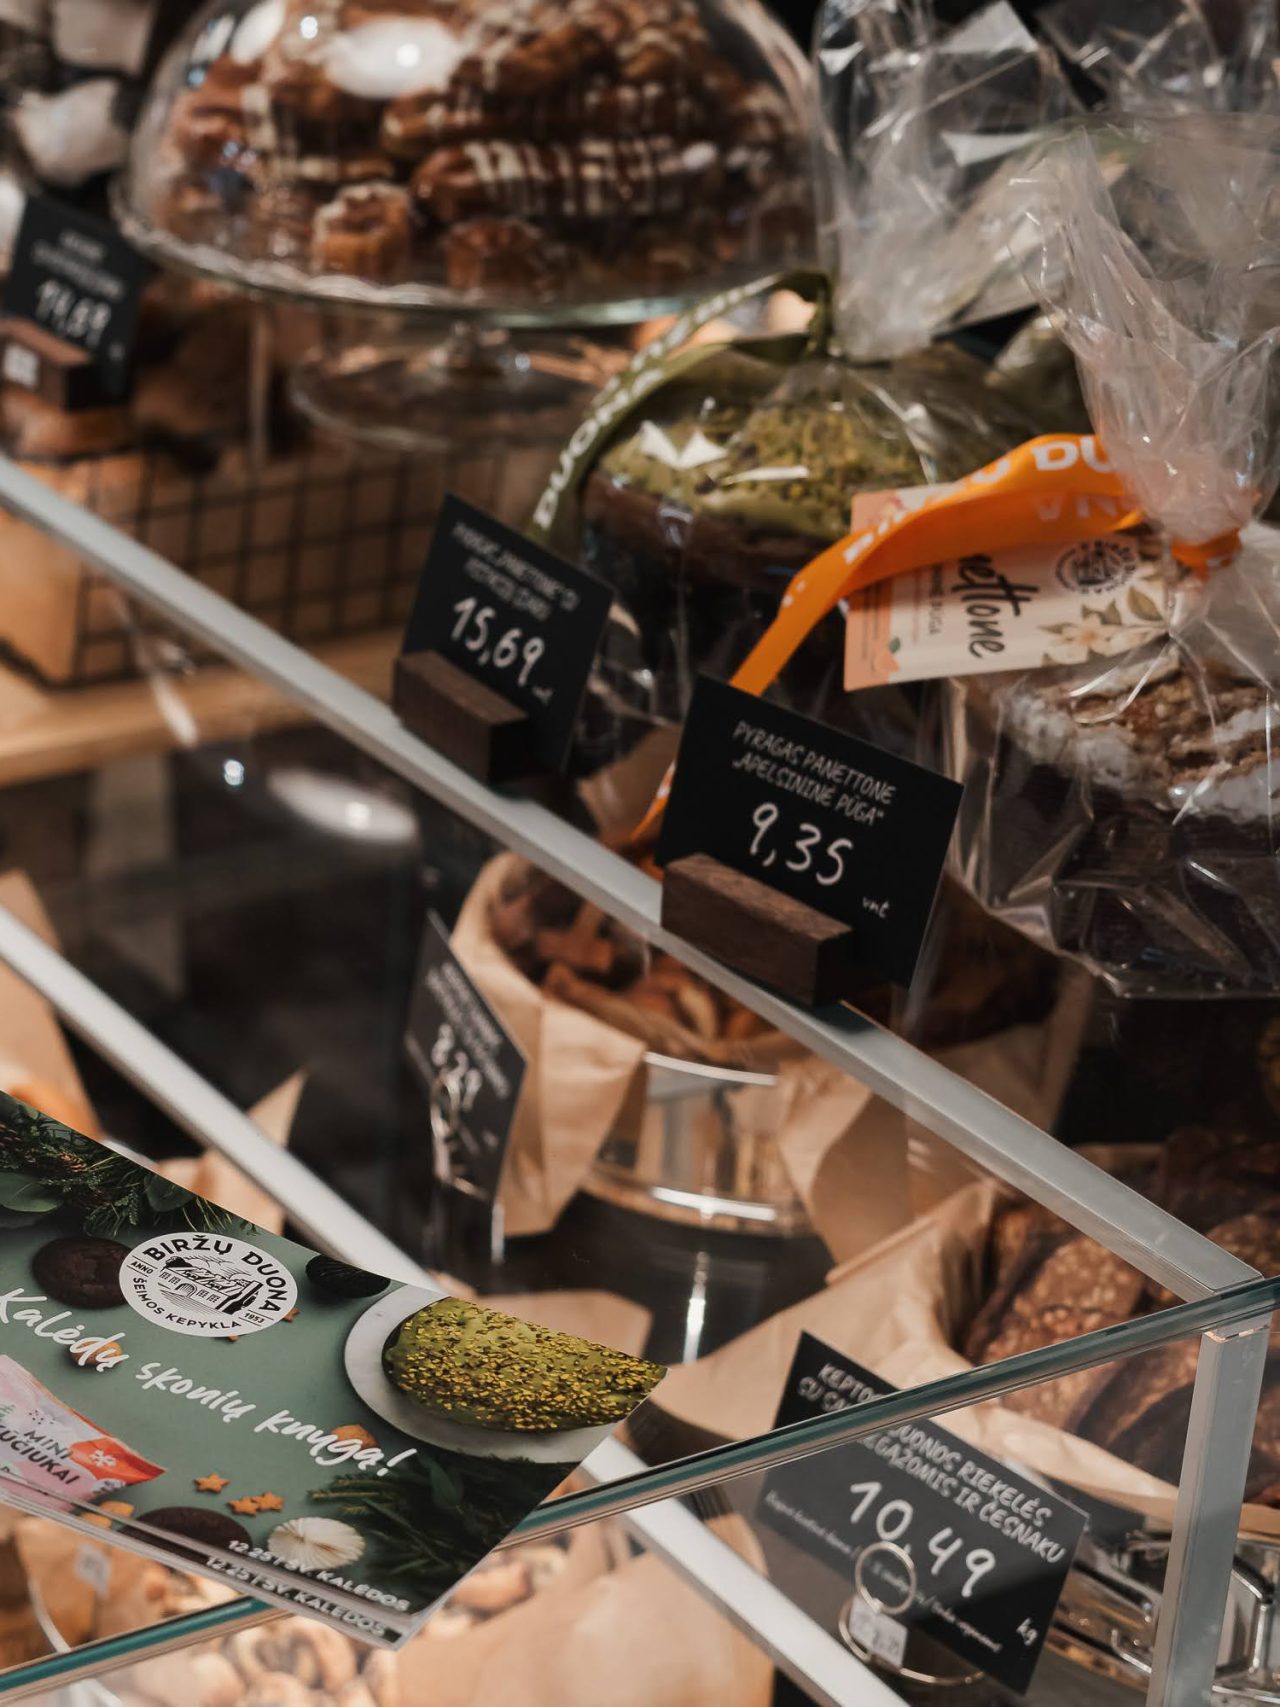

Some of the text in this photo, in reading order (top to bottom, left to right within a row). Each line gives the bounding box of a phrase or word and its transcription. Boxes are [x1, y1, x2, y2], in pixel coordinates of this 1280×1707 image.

[451, 597, 546, 687] 15,69
[732, 721, 897, 805] PYRAGAS PANETTONE
[750, 803, 854, 886] 9,35
[130, 1260, 154, 1275] ANNO
[132, 1277, 242, 1330] ŠEIMOS KEPYKLA
[142, 1234, 288, 1314] BIRŽŲ DUONA
[24, 1429, 74, 1460] MINI
[135, 1362, 257, 1424] skonių
[253, 1409, 418, 1477] knygą!
[954, 1487, 982, 1514] IR
[978, 1498, 1067, 1565] ČESNAKU
[956, 1459, 1054, 1528] RIEKELĖS
[1016, 1616, 1039, 1647] kg
